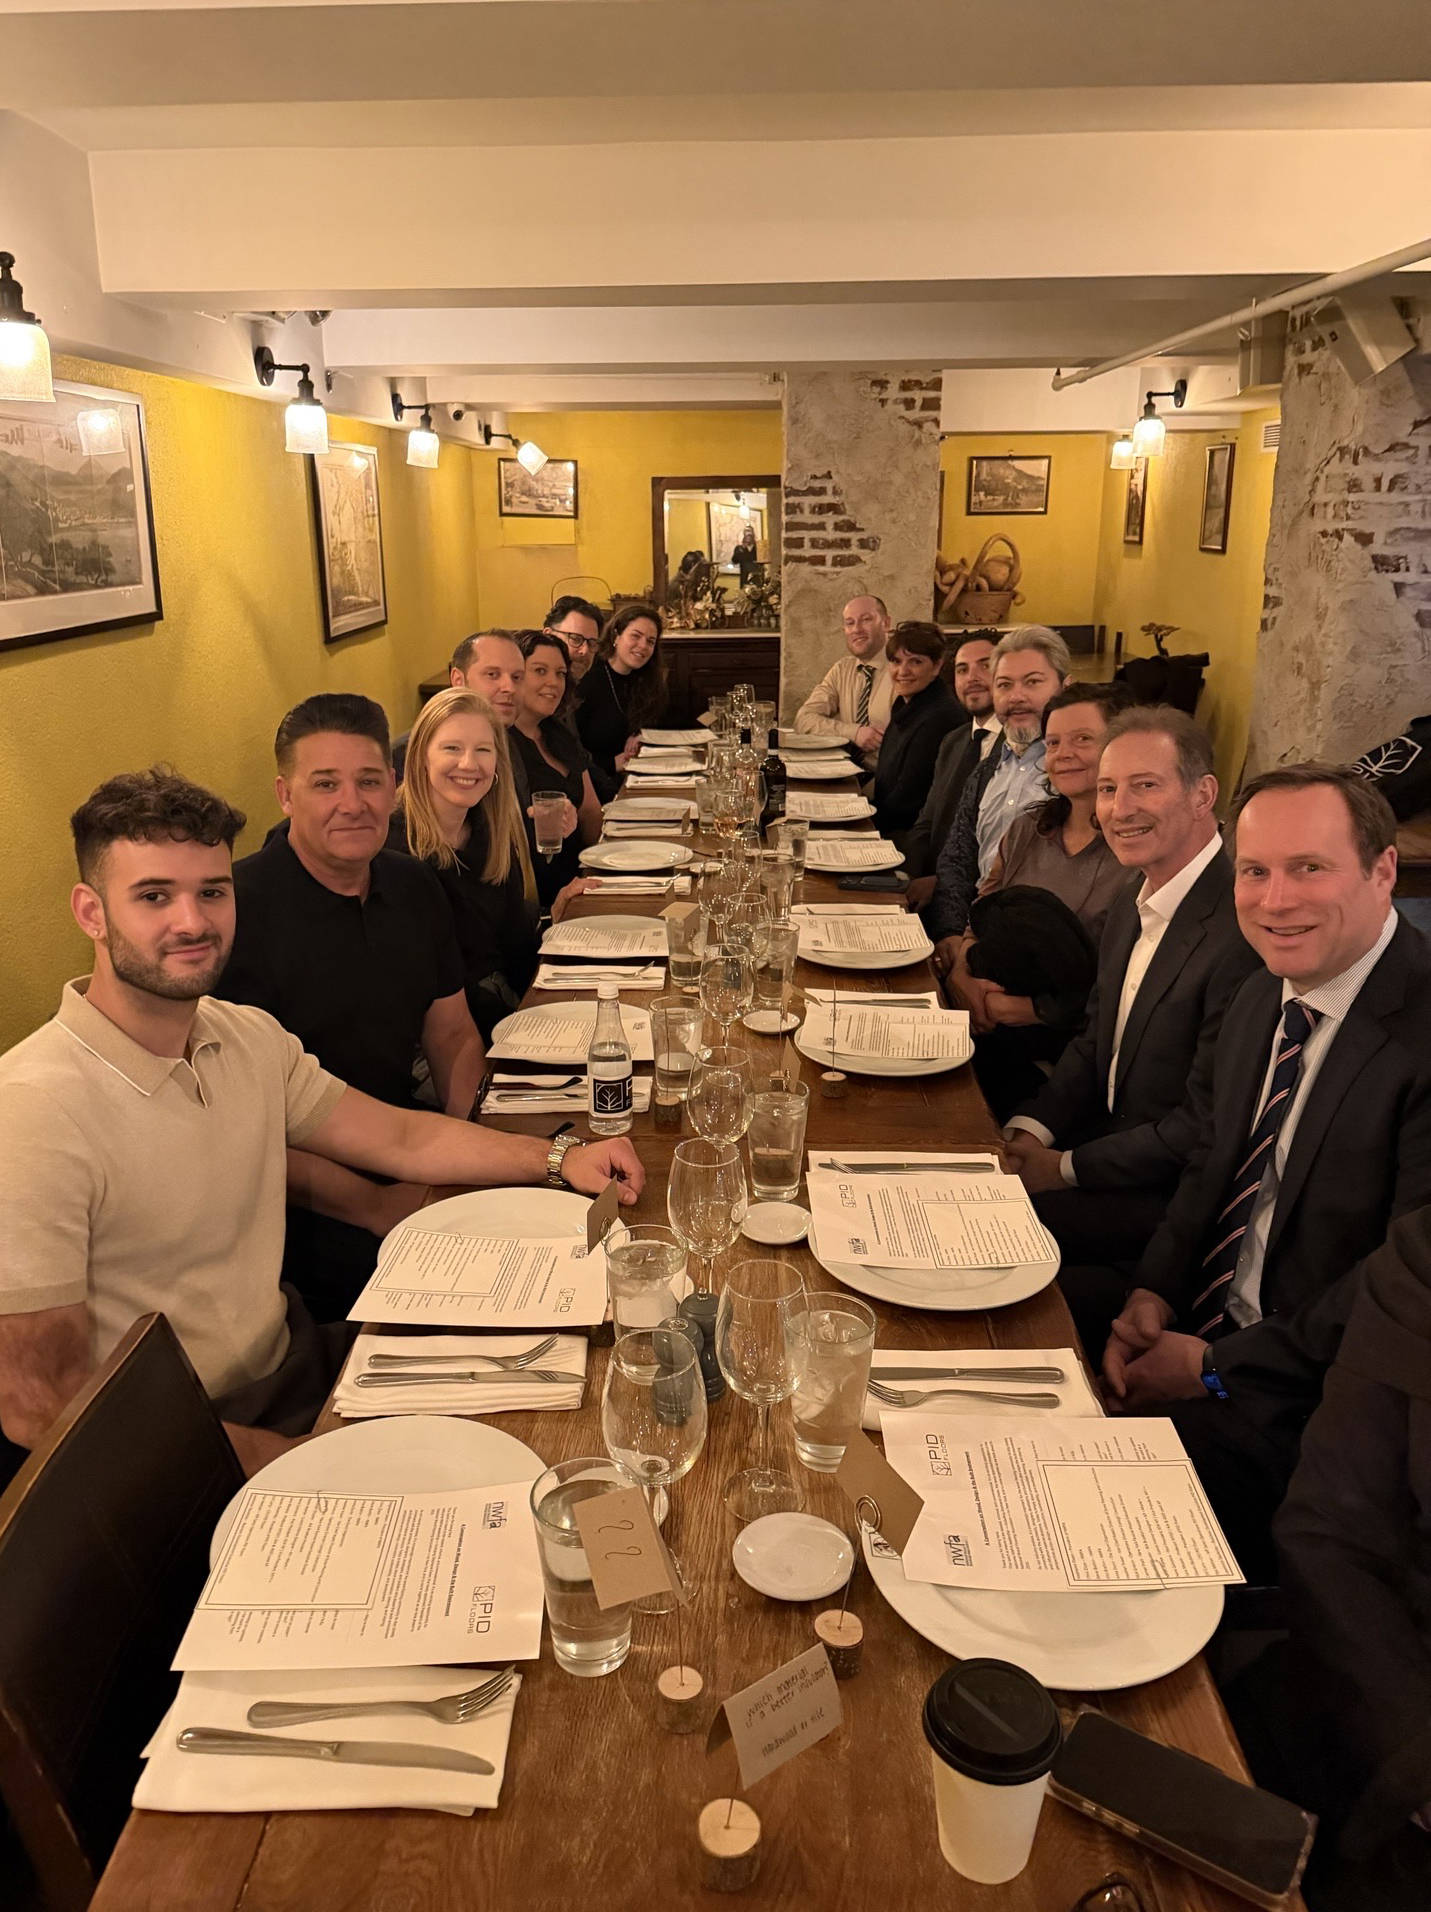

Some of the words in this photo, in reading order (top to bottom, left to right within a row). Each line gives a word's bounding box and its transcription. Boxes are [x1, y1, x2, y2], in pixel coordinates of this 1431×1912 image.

[925, 1433, 941, 1461] PID
[938, 1434, 949, 1461] FLOORS
[486, 1501, 507, 1530] nwfa
[943, 1534, 966, 1567] nwfa
[466, 1603, 478, 1634] FLOORS
[475, 1602, 494, 1634] PID
